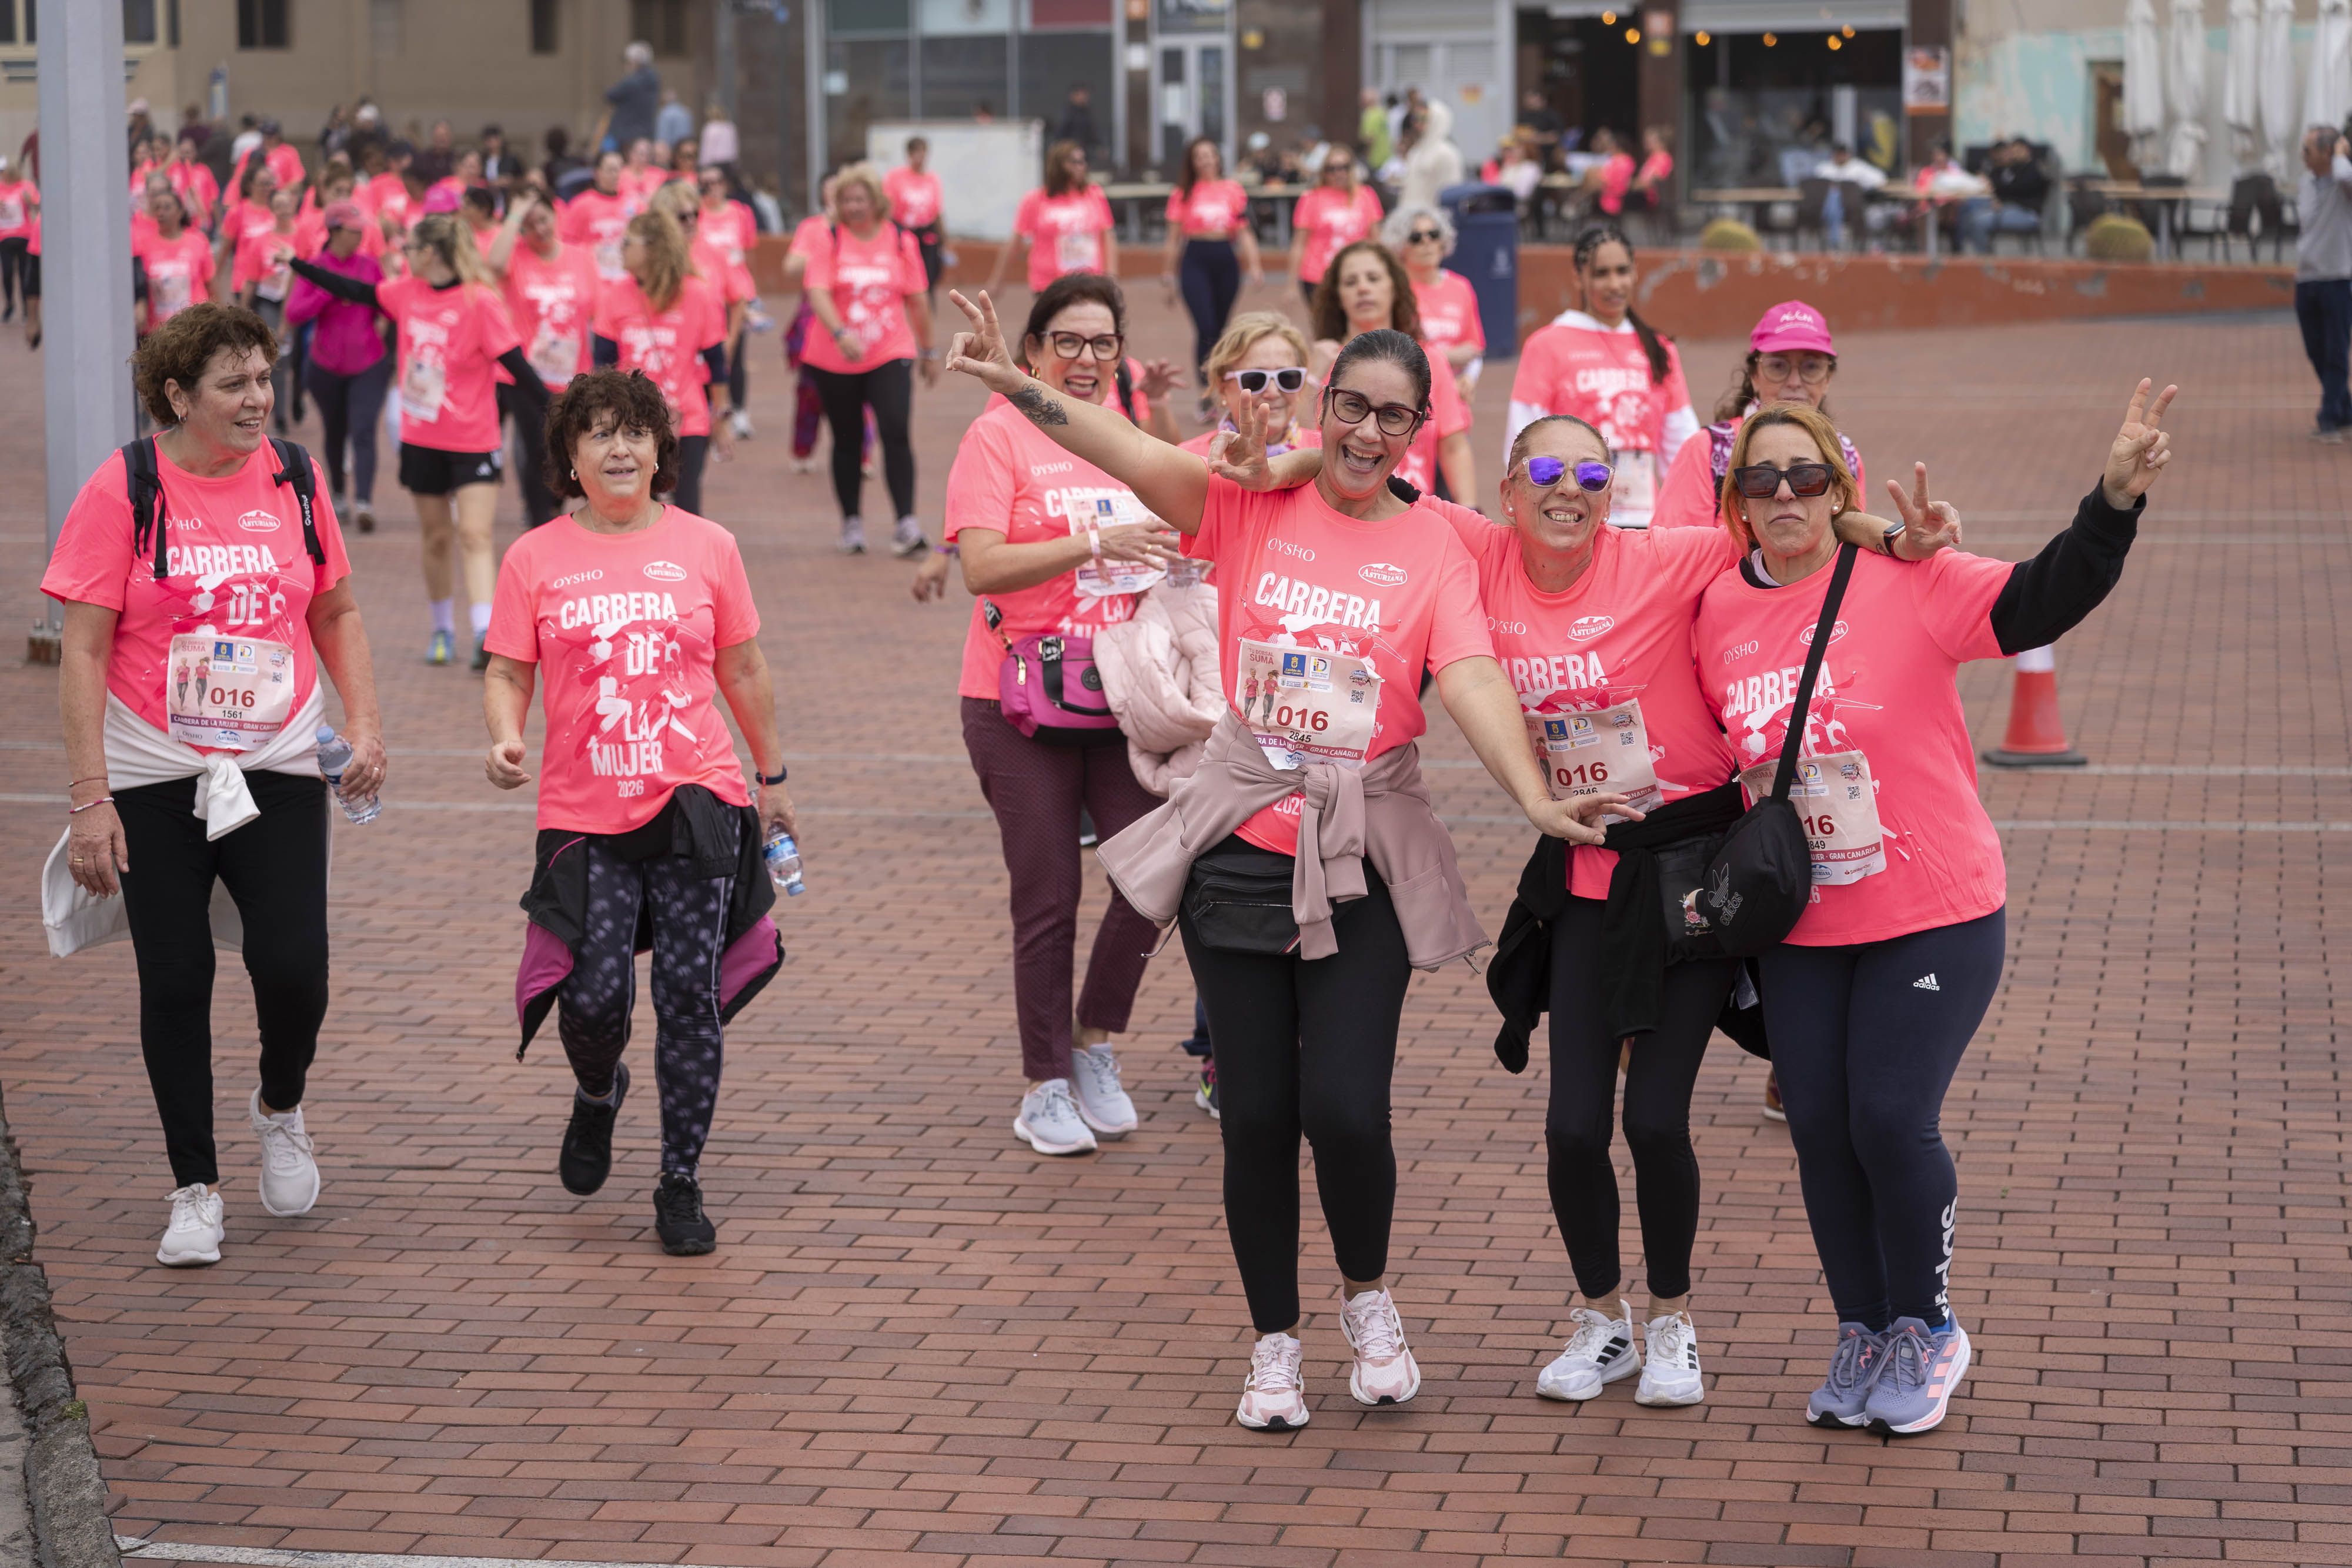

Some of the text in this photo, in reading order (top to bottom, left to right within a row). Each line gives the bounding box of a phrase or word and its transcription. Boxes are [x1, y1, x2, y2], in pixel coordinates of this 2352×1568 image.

[1031, 461, 1073, 476] OYSHO
[1268, 538, 1316, 562] OYSHO
[166, 544, 279, 577] CARRERA
[553, 569, 603, 589] OYSHO
[1362, 569, 1404, 583] ASTURIANA
[226, 583, 265, 626] DE
[560, 591, 679, 630] CARRERA
[1254, 571, 1380, 633] CARRERA
[1571, 621, 1611, 637] ASTURIANA
[626, 631, 664, 676] DE
[1250, 654, 1274, 665] SUMA
[1723, 640, 1759, 664] OYSHO
[1500, 651, 1609, 692] ARRERA
[211, 687, 255, 707] 016
[173, 716, 200, 726] CARRERA
[222, 710, 243, 719] 1561
[624, 700, 650, 742] LA
[1277, 706, 1329, 731] 016
[1288, 731, 1312, 743] 2845
[590, 740, 664, 777] MUJER
[1330, 749, 1359, 758] CANARIA
[1556, 762, 1608, 786] 016
[1750, 771, 1774, 779] SUMA
[617, 780, 644, 798] 2026
[1626, 788, 1653, 800] ANARIA
[1799, 815, 1835, 835] 16
[1847, 847, 1876, 859] CANARIA
[1720, 892, 1743, 926] adidas
[1913, 981, 1940, 991] adidas
